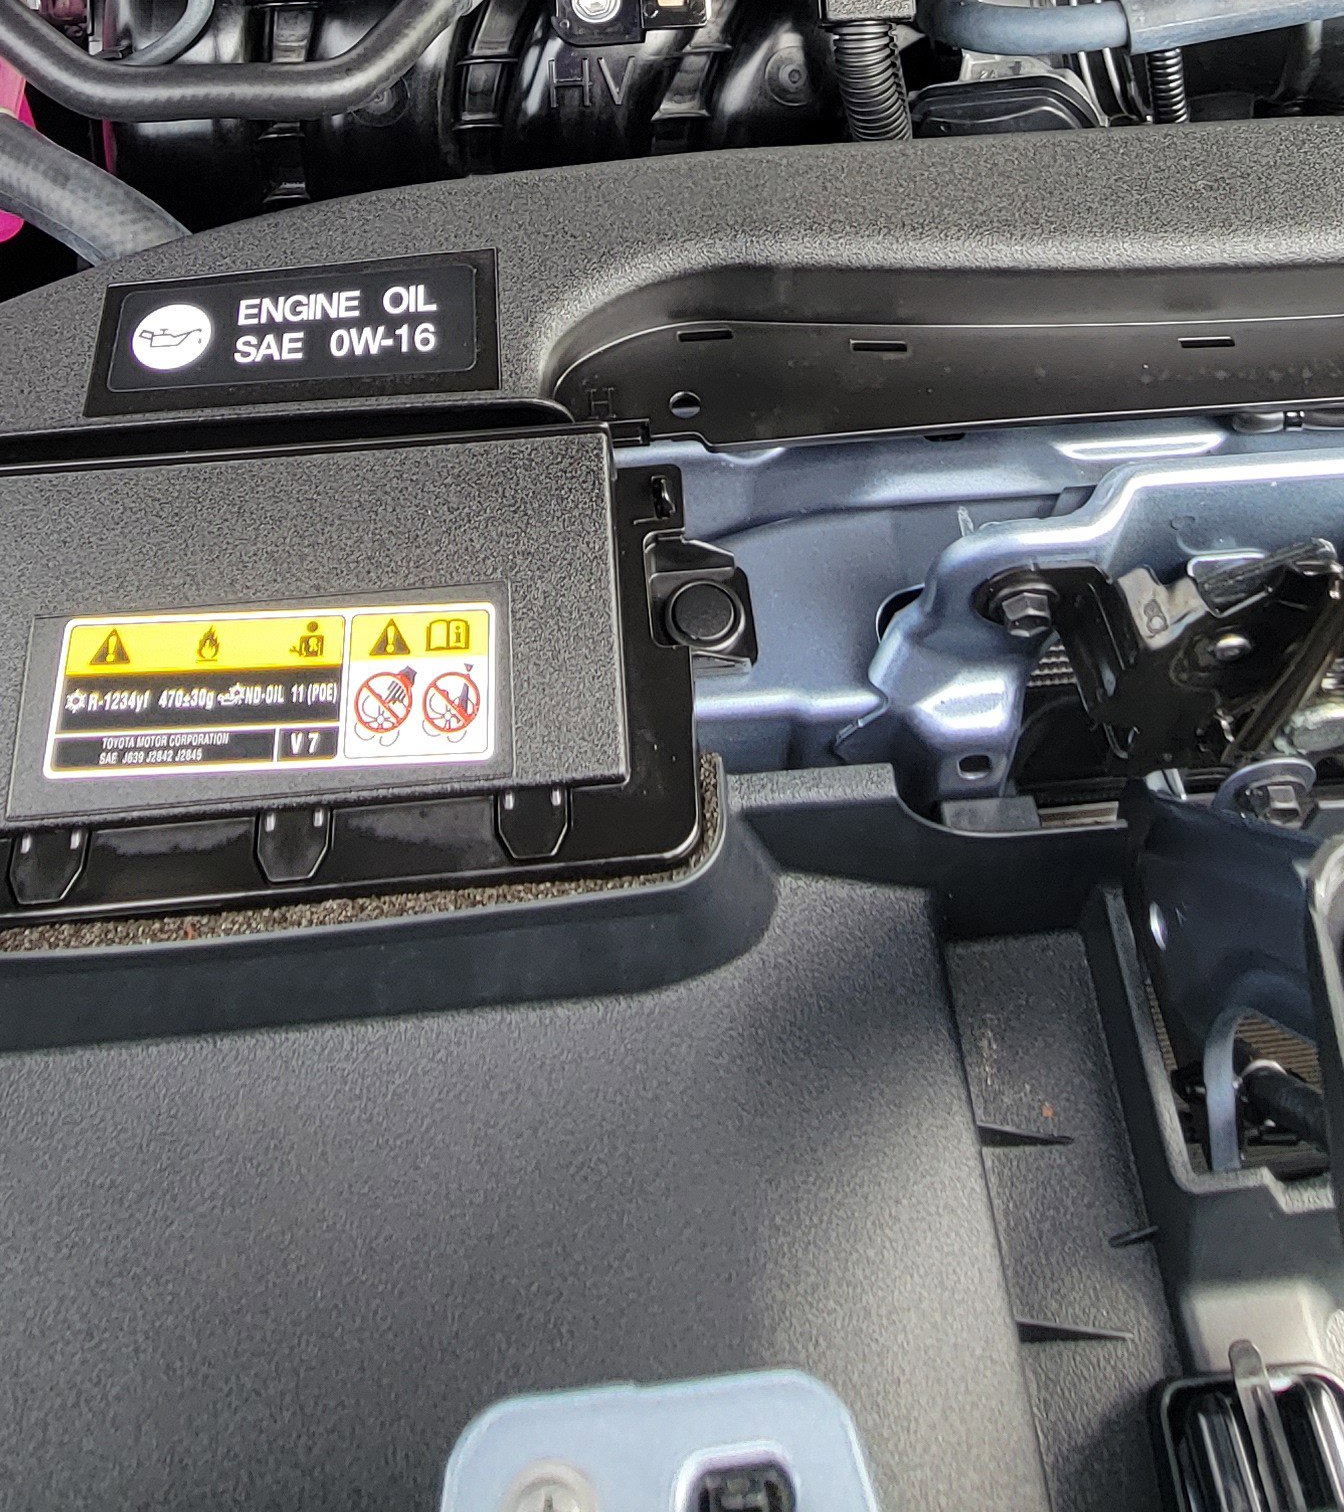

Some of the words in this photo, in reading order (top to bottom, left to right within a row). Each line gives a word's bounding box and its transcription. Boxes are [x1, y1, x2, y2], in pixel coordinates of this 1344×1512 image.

[547, 54, 636, 108] HV
[237, 289, 361, 326] ENGINE
[382, 284, 438, 314] OIL
[233, 331, 305, 364] SAE
[329, 322, 436, 357] 0W-16
[87, 689, 151, 713] R-1234yf
[291, 682, 304, 704] 11
[307, 681, 337, 706] (POE)
[102, 736, 135, 749] TOYOTA
[136, 735, 167, 748] MOTOR
[169, 732, 230, 746] CORPORATION
[307, 731, 319, 755] 7
[99, 751, 119, 765] SAE
[122, 751, 145, 764] J639
[146, 749, 173, 763] J2842
